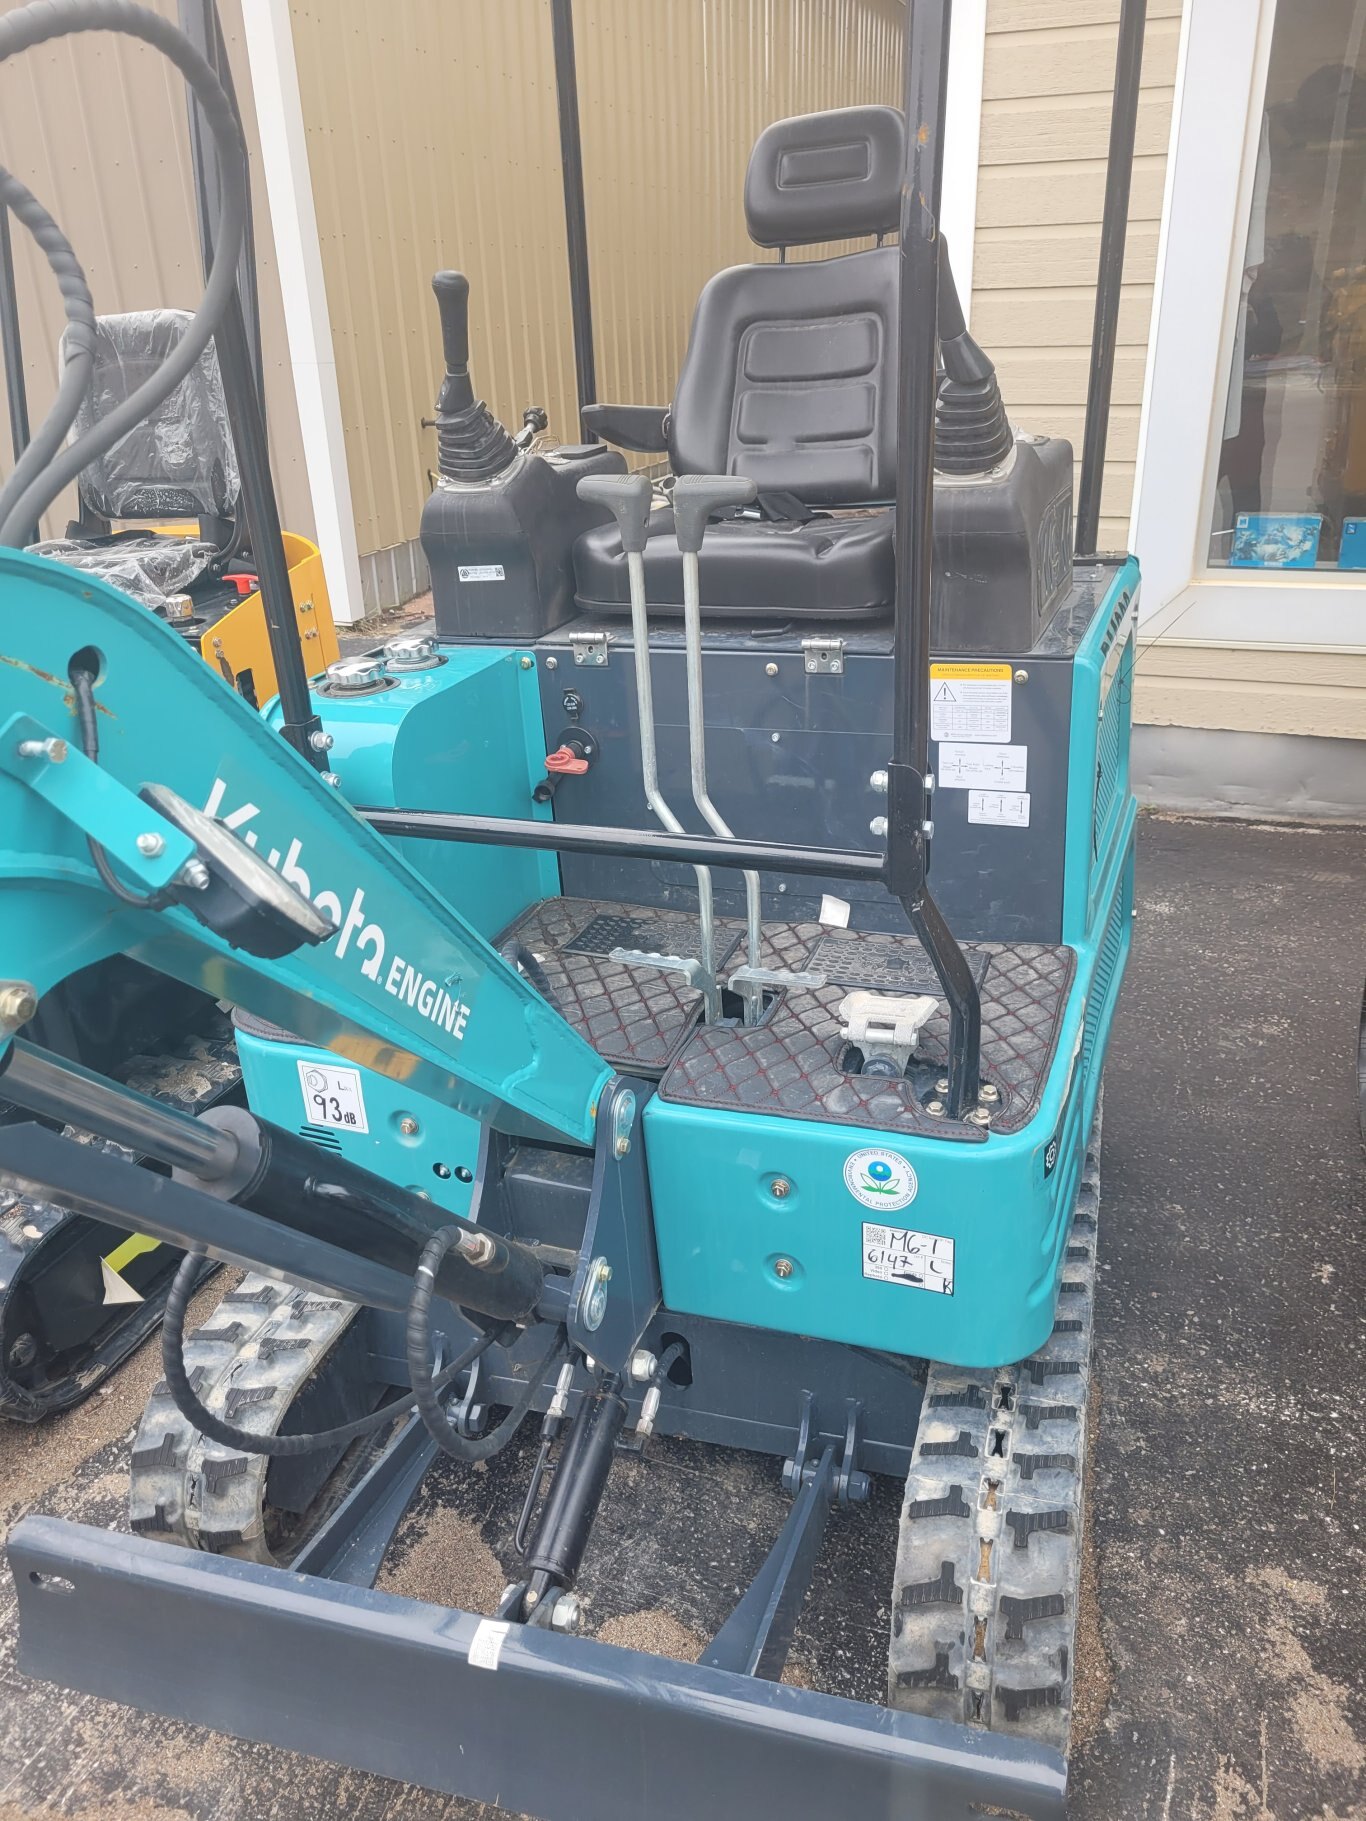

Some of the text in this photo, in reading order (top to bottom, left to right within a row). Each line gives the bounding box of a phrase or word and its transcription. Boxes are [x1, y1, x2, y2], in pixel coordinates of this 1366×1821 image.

[384, 955, 471, 1041] ENGINE
[313, 1094, 357, 1125] 93 dB
[856, 1150, 902, 1165] UNITED STATES
[847, 1161, 914, 1207] ENVIRONMENTAL PROTECTION AGENCY
